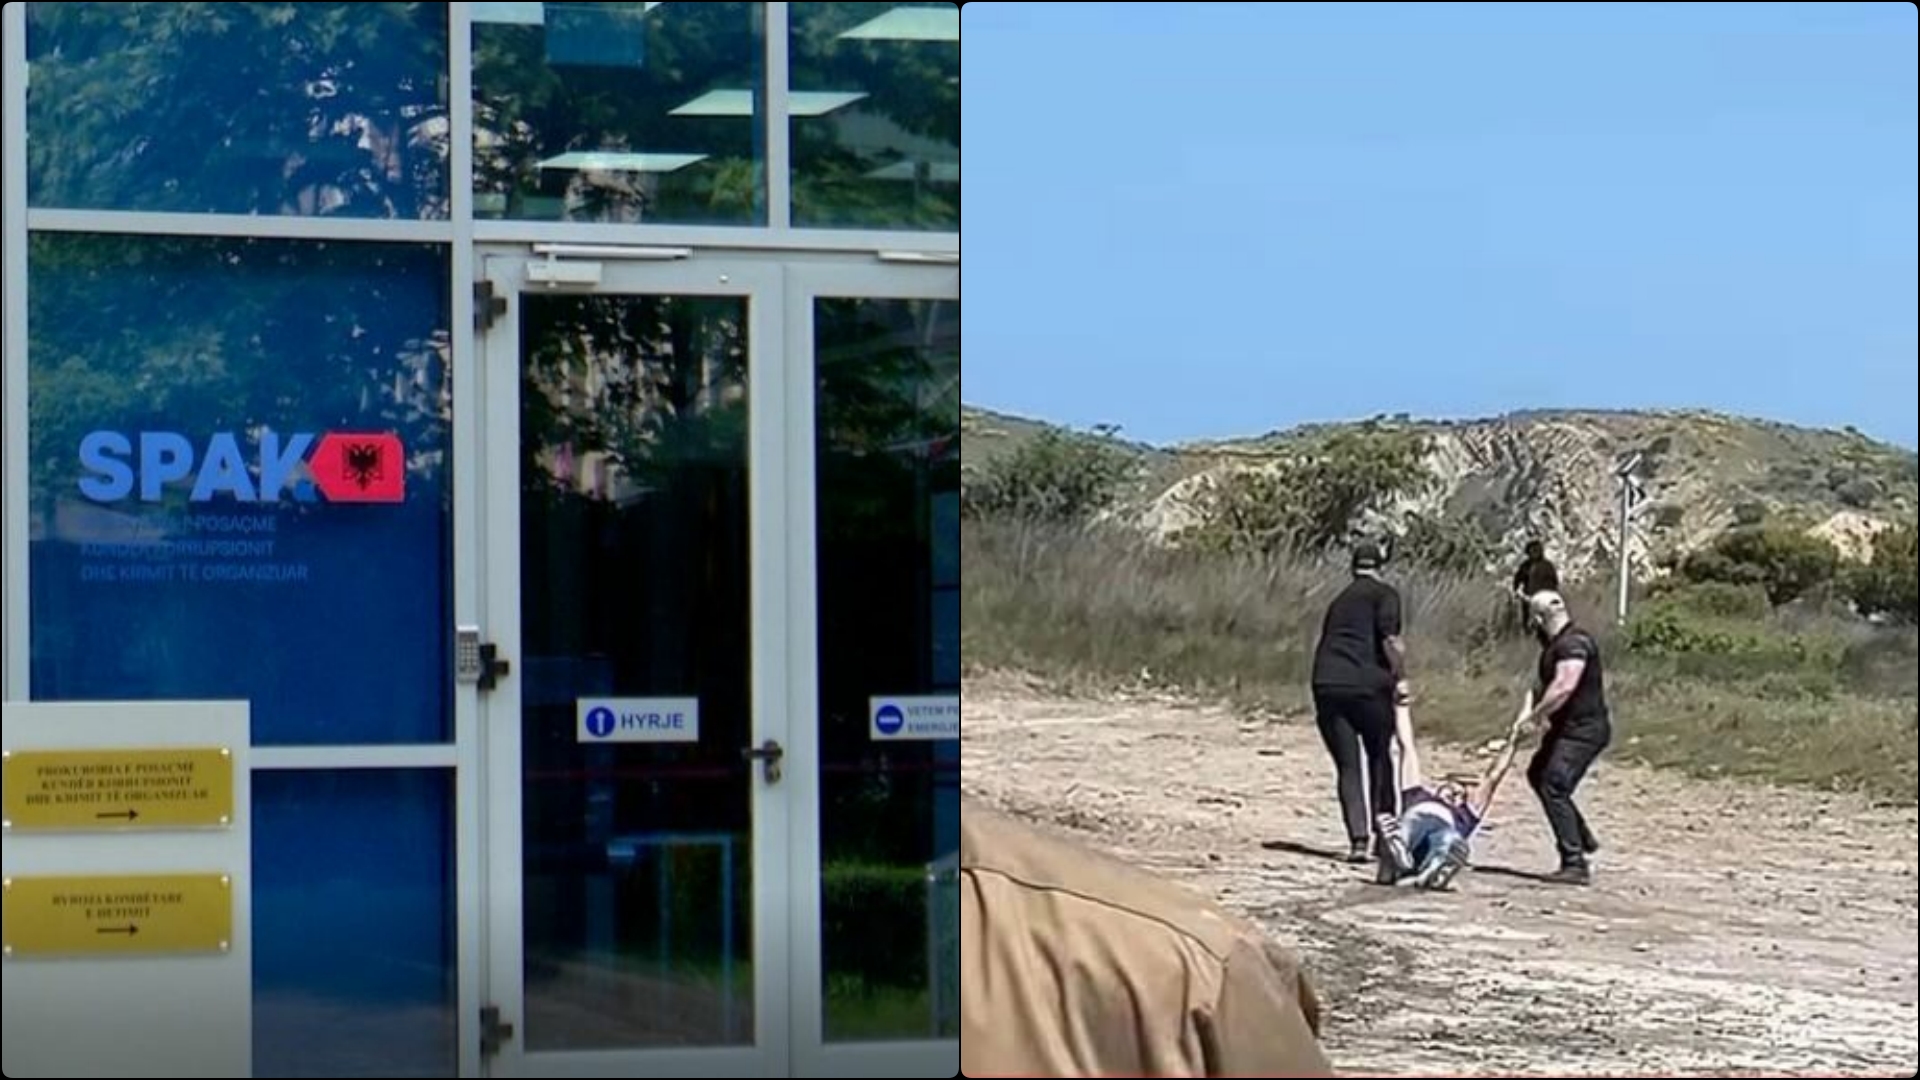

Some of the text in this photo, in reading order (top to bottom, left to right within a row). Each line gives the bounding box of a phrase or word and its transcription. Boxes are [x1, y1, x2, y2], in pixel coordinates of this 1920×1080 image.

[78, 430, 316, 502] SPAK
[81, 564, 117, 582] DHE
[620, 713, 684, 730] HYRJE
